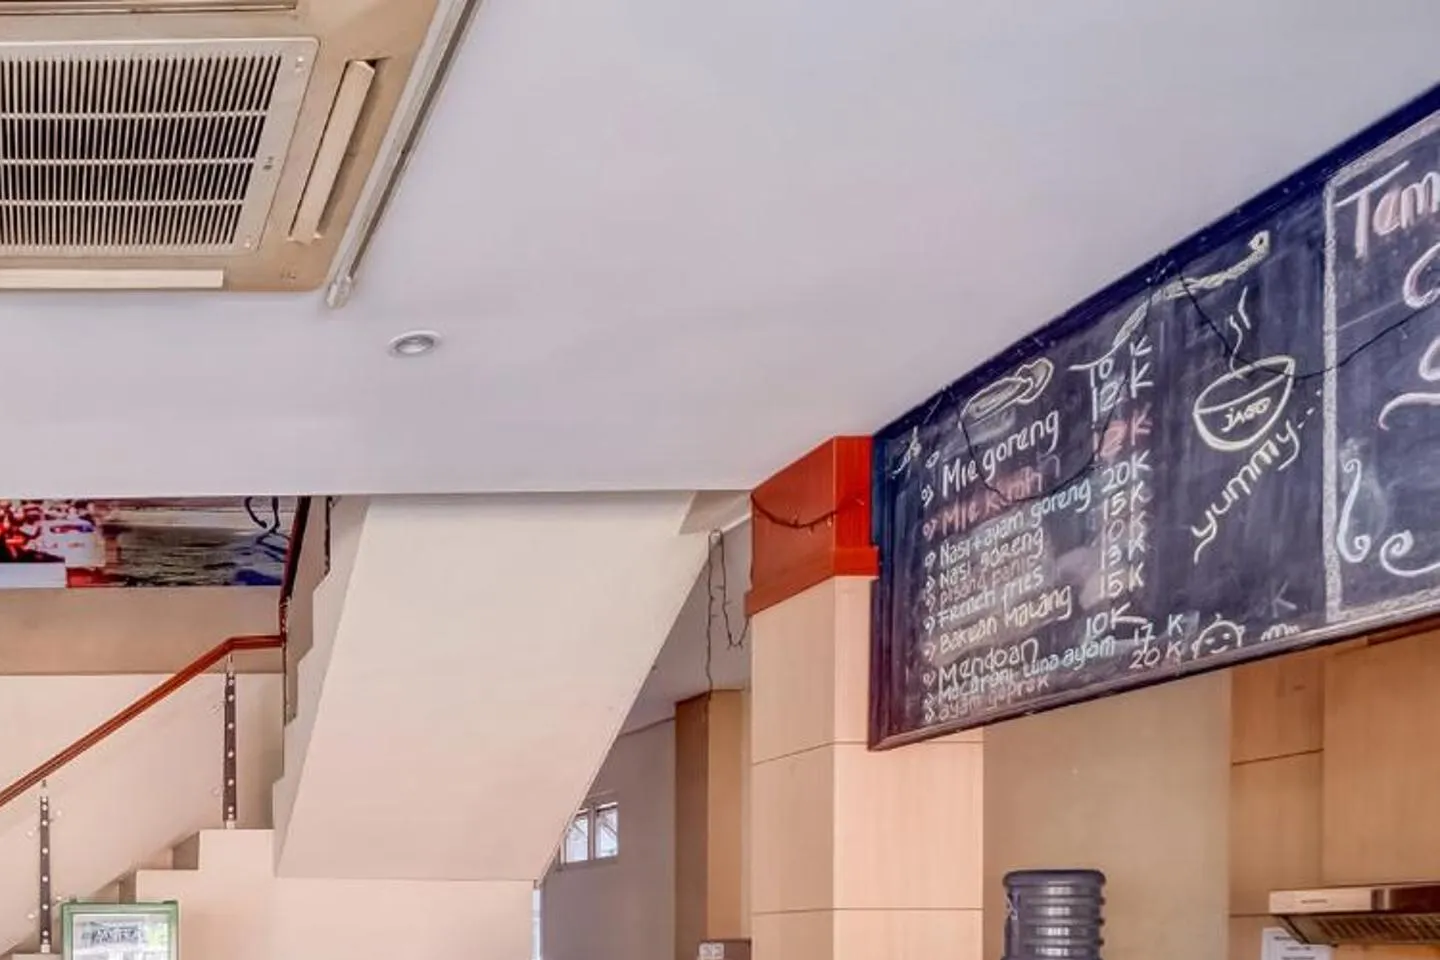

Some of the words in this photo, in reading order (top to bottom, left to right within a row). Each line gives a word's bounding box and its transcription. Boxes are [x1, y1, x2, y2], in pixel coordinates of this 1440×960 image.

[942, 457, 979, 498] Mie
[982, 410, 1059, 483] goreng
[942, 498, 980, 536] Mie
[1030, 478, 1092, 528] goreng
[939, 560, 972, 590] Nasi
[1003, 584, 1073, 628] Malang
[938, 636, 1040, 704] Mendoan
[1128, 649, 1161, 669] 20
